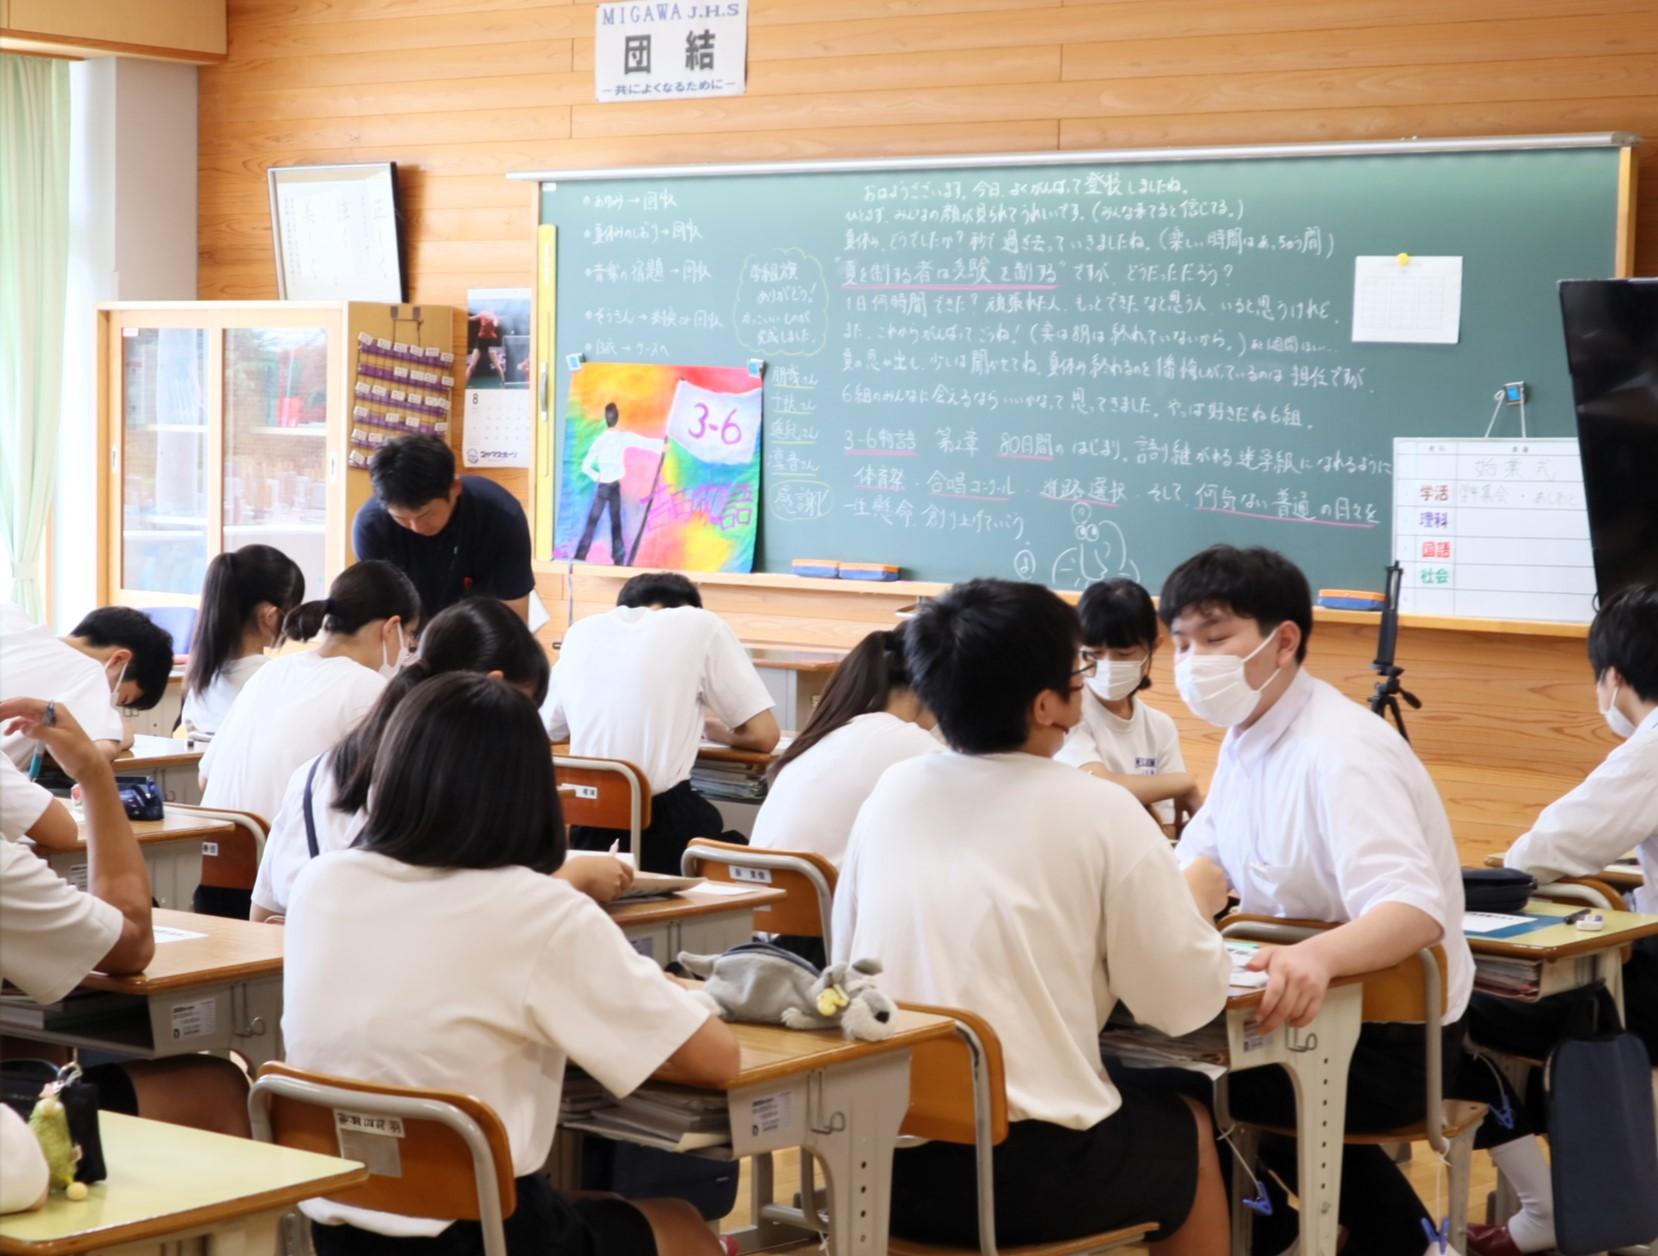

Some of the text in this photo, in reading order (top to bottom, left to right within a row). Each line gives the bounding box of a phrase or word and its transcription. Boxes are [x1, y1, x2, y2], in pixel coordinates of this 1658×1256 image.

[602, 3, 740, 25] MIGAWA J.H.S
[624, 28, 716, 76] 団結
[687, 402, 742, 445] 3-6
[1419, 484, 1449, 502] 学活
[1419, 511, 1448, 529] 理科
[1421, 541, 1451, 559] 国語
[1419, 567, 1449, 584] 社会
